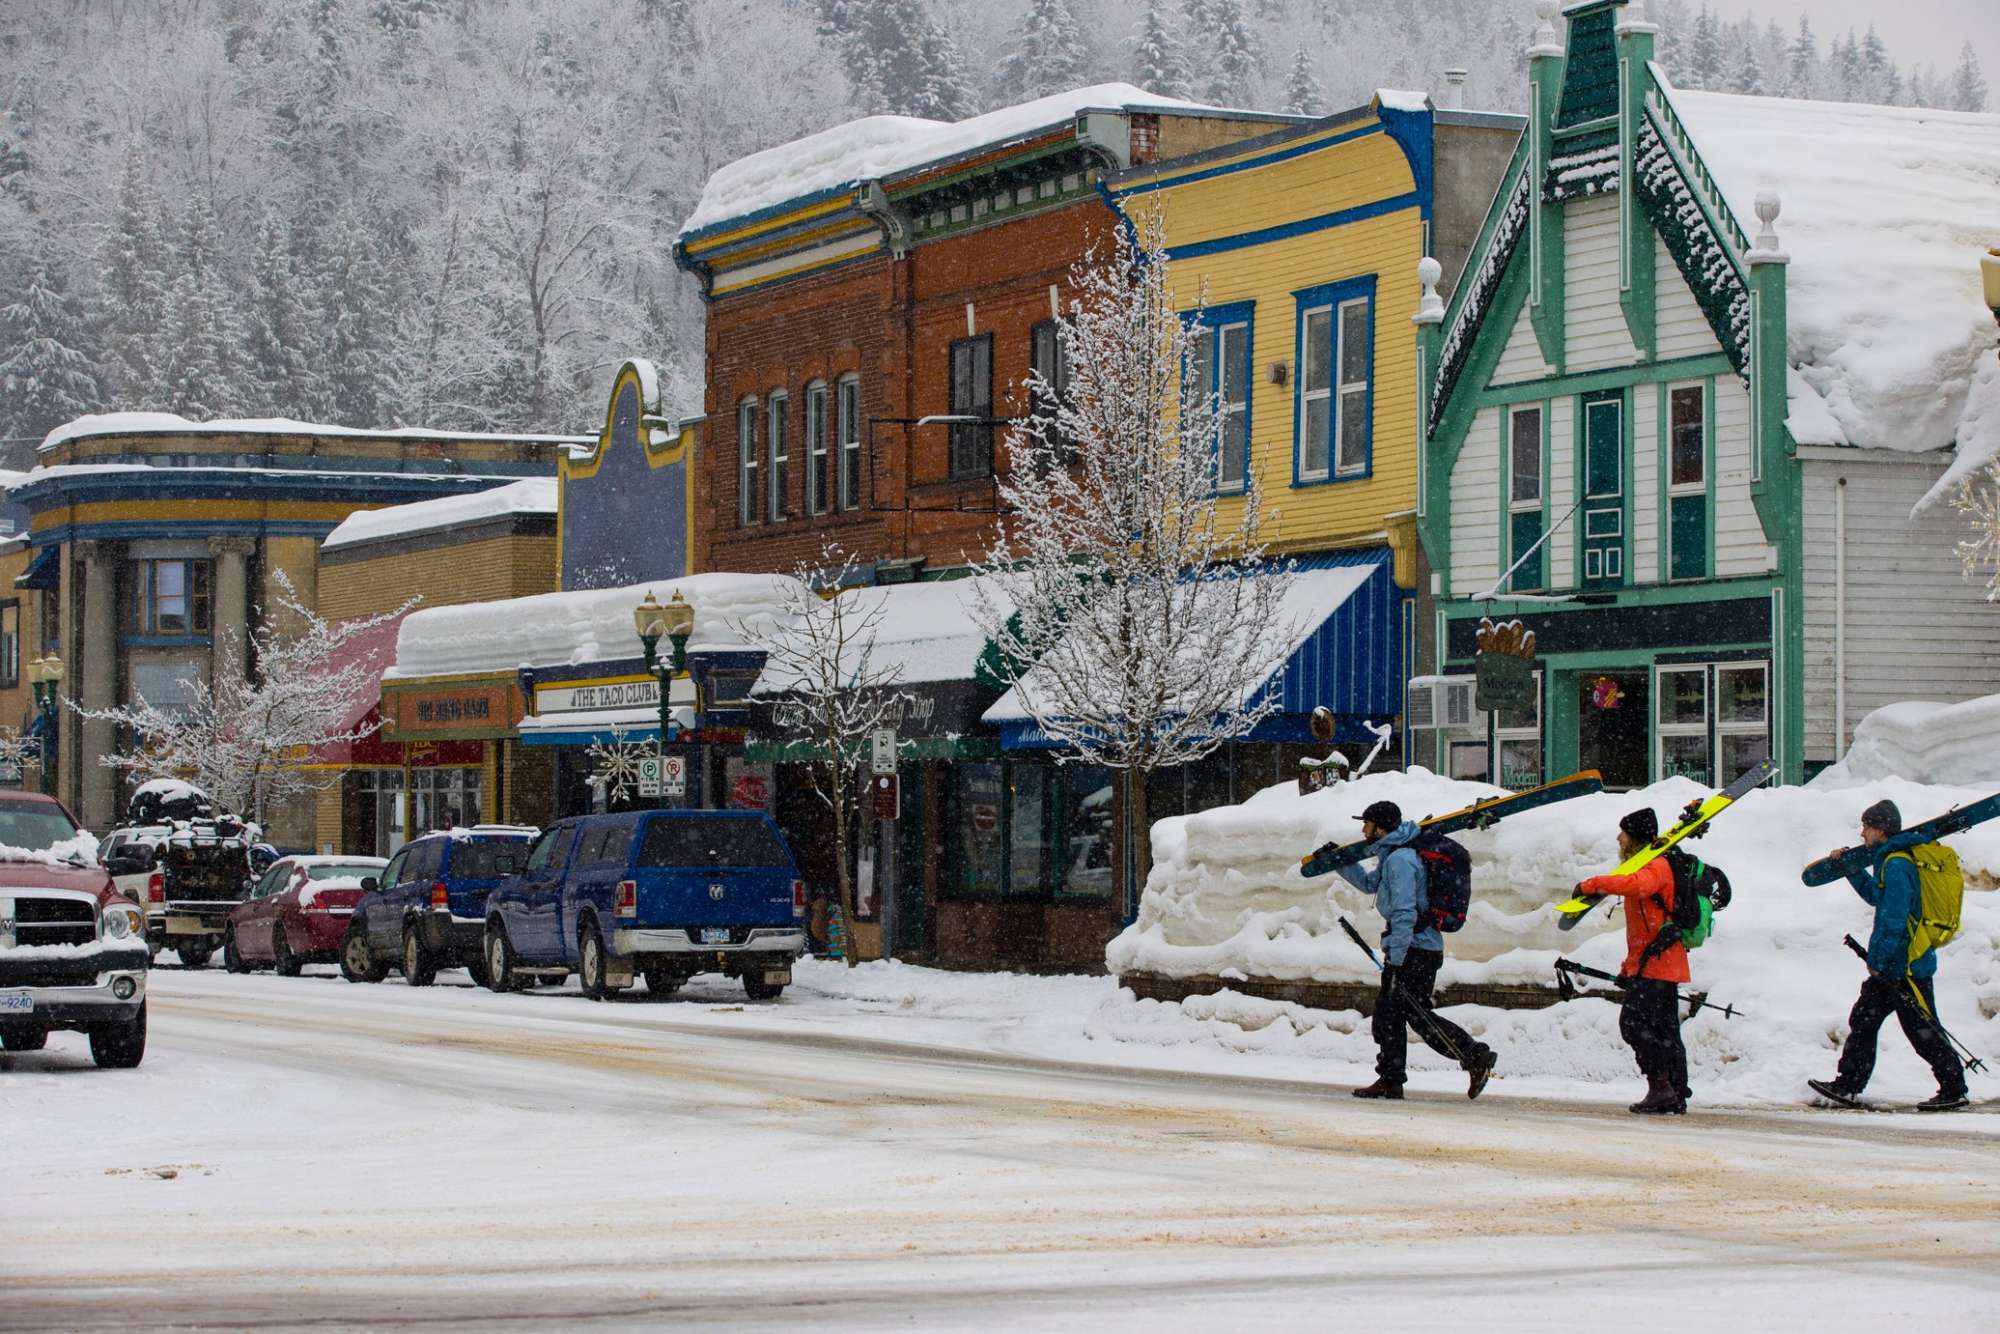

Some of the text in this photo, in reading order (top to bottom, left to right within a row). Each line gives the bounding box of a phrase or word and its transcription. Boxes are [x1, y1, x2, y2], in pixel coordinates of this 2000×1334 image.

[1484, 678, 1522, 688] Modern
[577, 683, 652, 707] THE TACO CLUB
[1502, 766, 1538, 785] Modern
